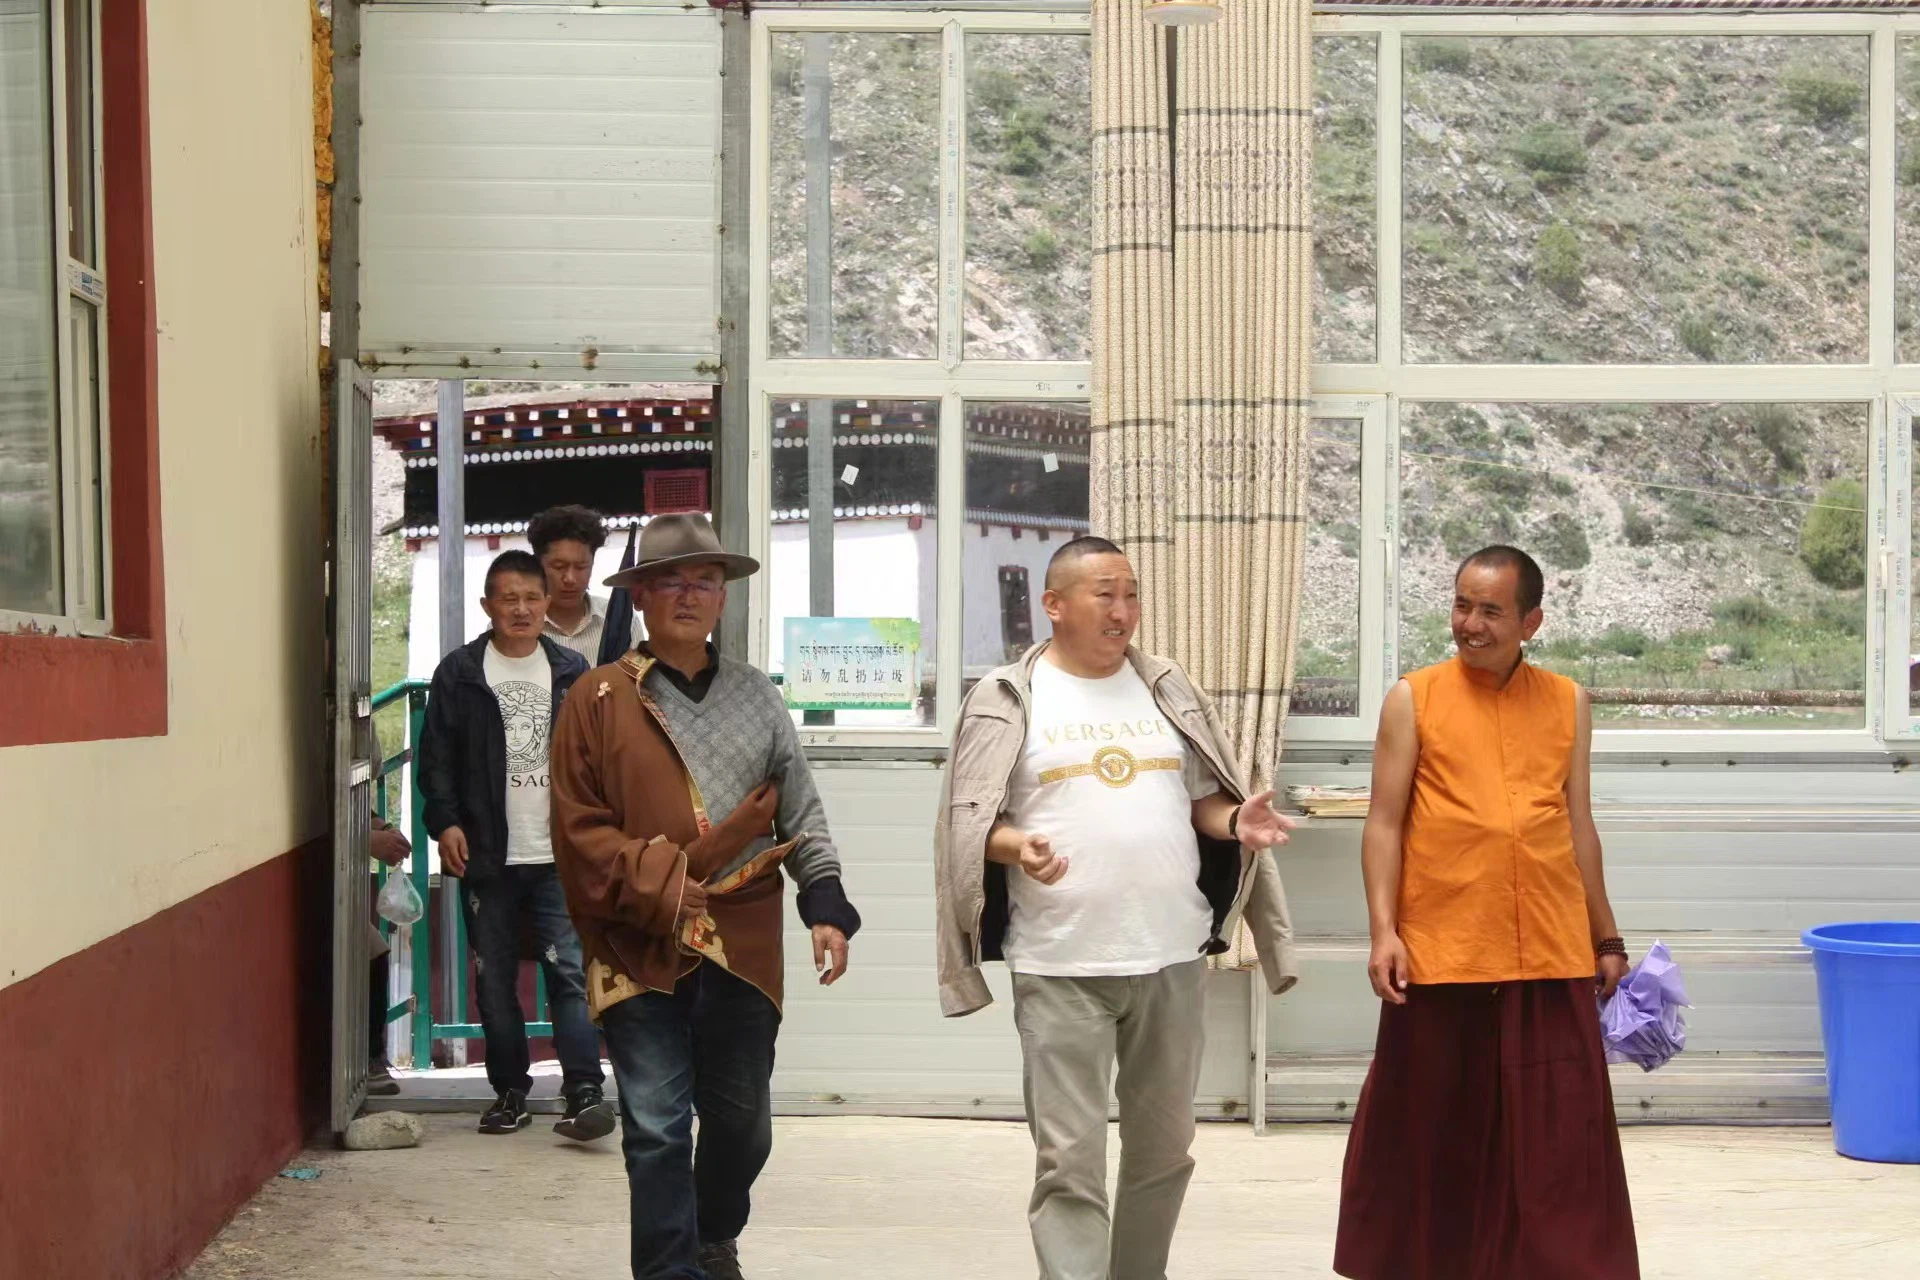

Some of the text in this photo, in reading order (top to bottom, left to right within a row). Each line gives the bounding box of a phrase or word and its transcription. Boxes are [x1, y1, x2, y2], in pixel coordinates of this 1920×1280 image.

[802, 668, 903, 683] 请勿乱扔垃圾
[1043, 720, 1168, 744] VERSACE
